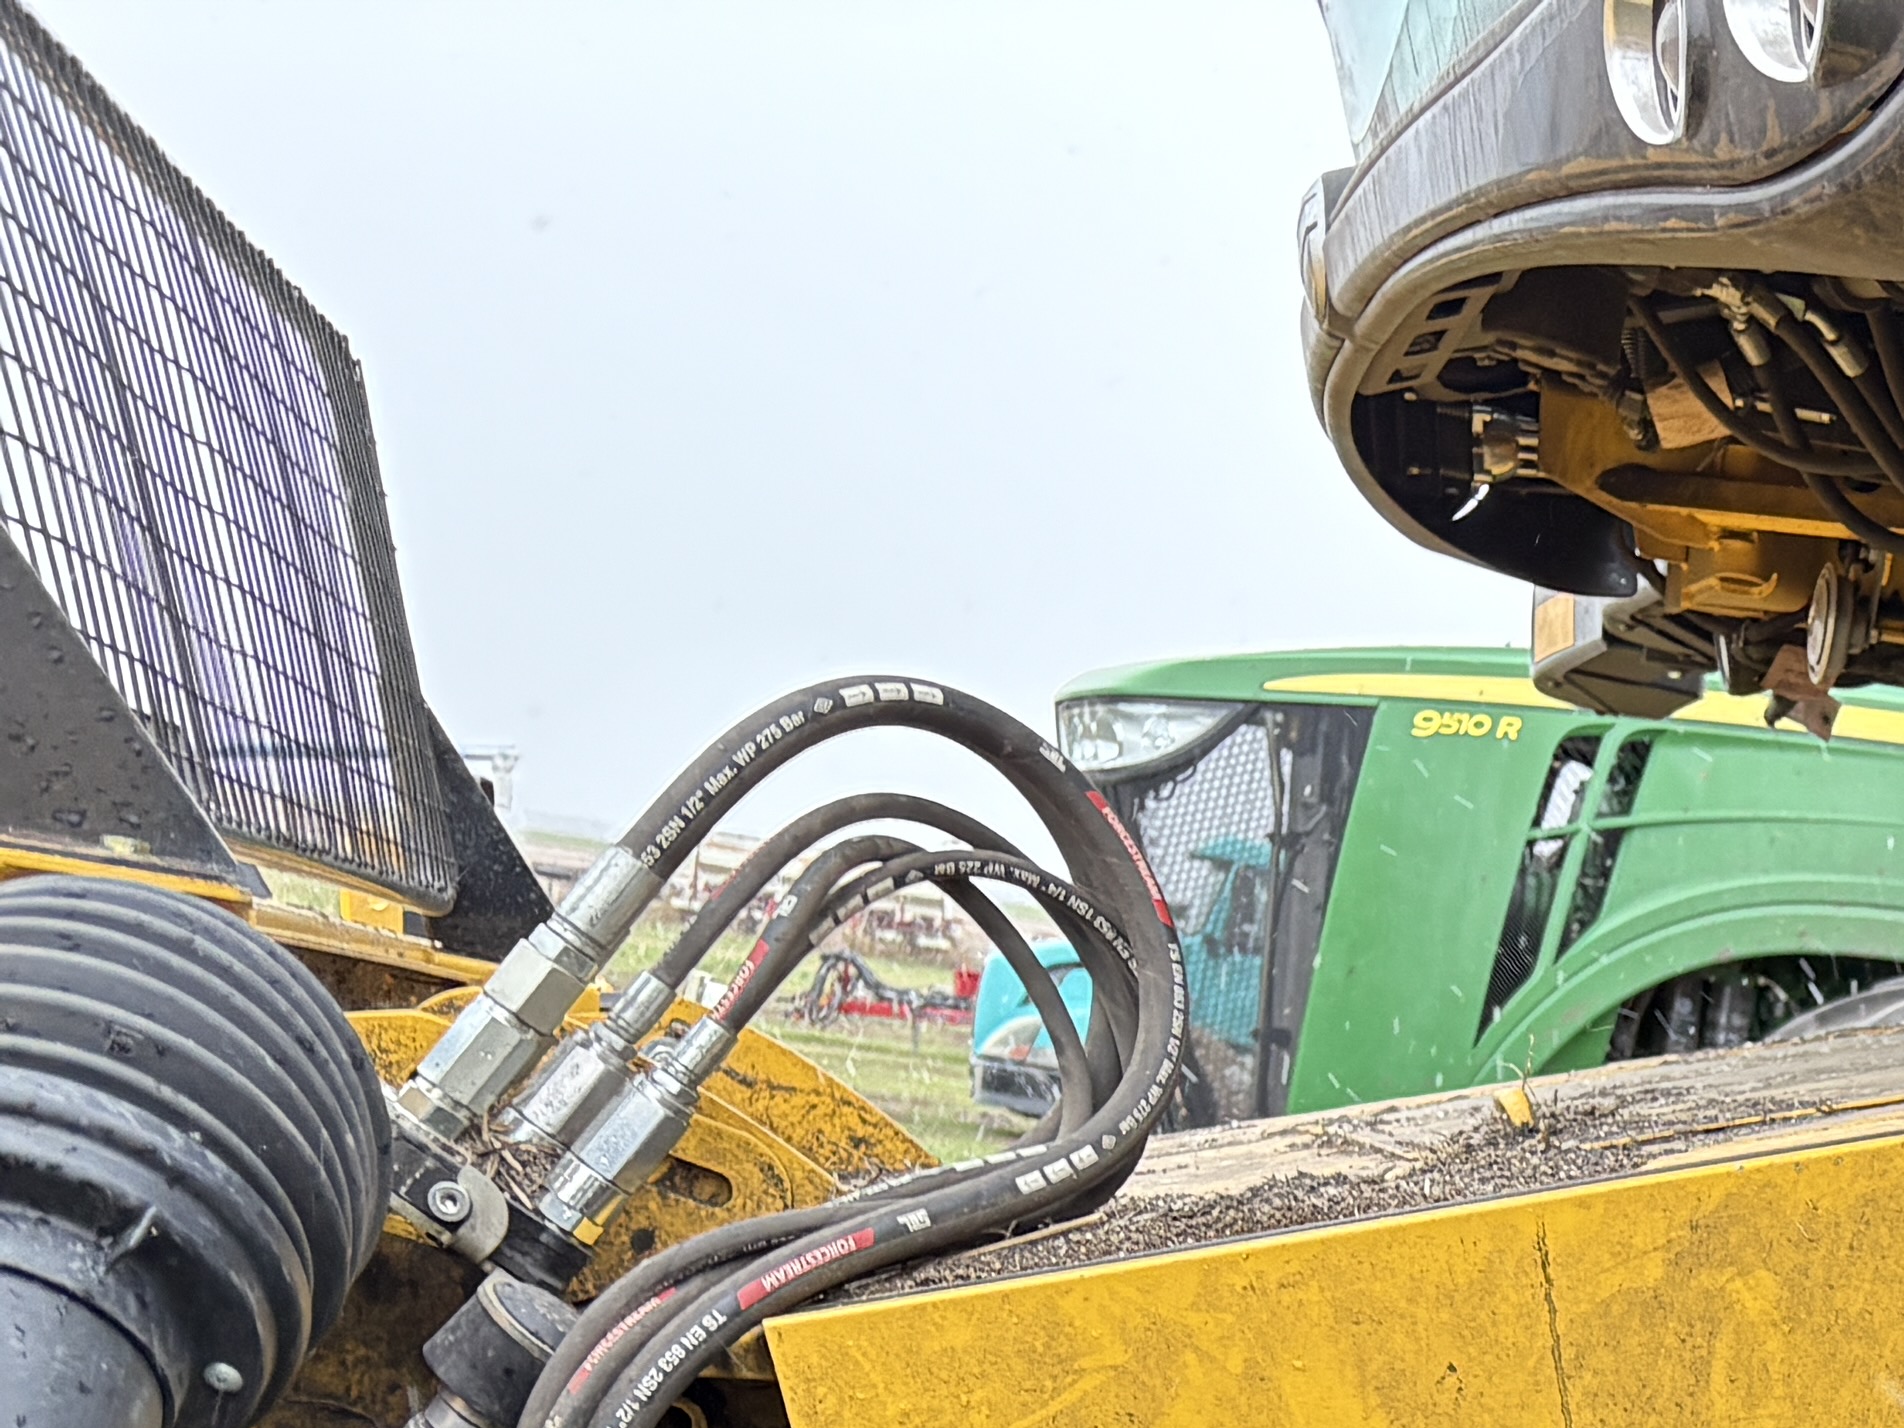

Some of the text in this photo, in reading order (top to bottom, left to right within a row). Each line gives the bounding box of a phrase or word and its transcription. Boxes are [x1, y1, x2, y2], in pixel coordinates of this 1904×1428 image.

[1411, 709, 1522, 740] 9510 R
[639, 845, 660, 870] 53
[656, 815, 685, 848] 2SN
[704, 765, 737, 794] Max.
[732, 741, 756, 766] WP
[756, 723, 782, 749] 275
[779, 711, 804, 731] Bar
[760, 1233, 859, 1292] FORCESTREAM
[701, 1305, 727, 1331] TS
[680, 1324, 706, 1350] EN
[658, 1344, 685, 1371] 853
[633, 1366, 663, 1400] 2SN
